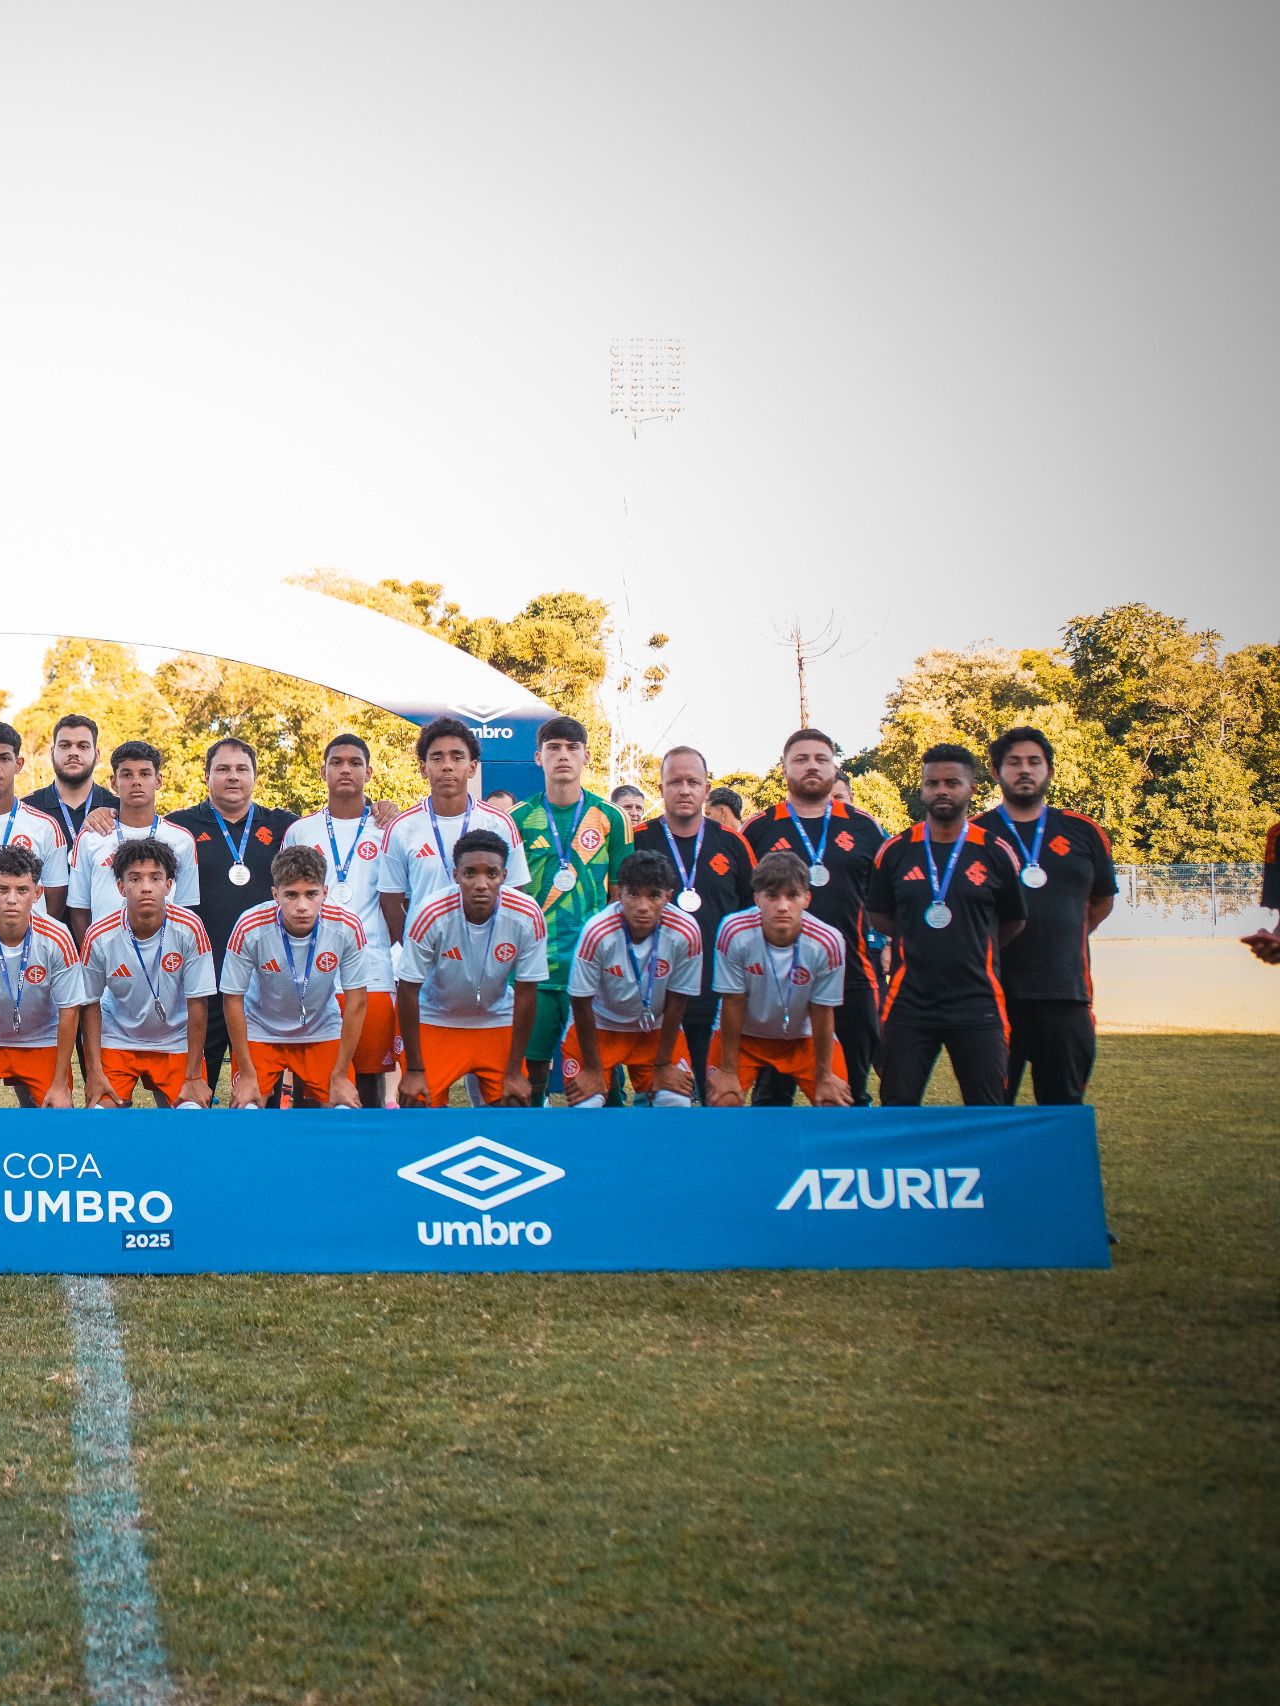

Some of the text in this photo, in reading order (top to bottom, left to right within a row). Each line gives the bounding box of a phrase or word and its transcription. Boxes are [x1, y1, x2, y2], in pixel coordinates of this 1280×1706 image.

[468, 724, 513, 739] mbro
[4, 1152, 102, 1179] COPA
[777, 1168, 984, 1210] AZURIZ
[4, 1190, 173, 1224] UMBRO
[125, 1233, 171, 1248] 2025
[417, 1214, 552, 1246] umbro
